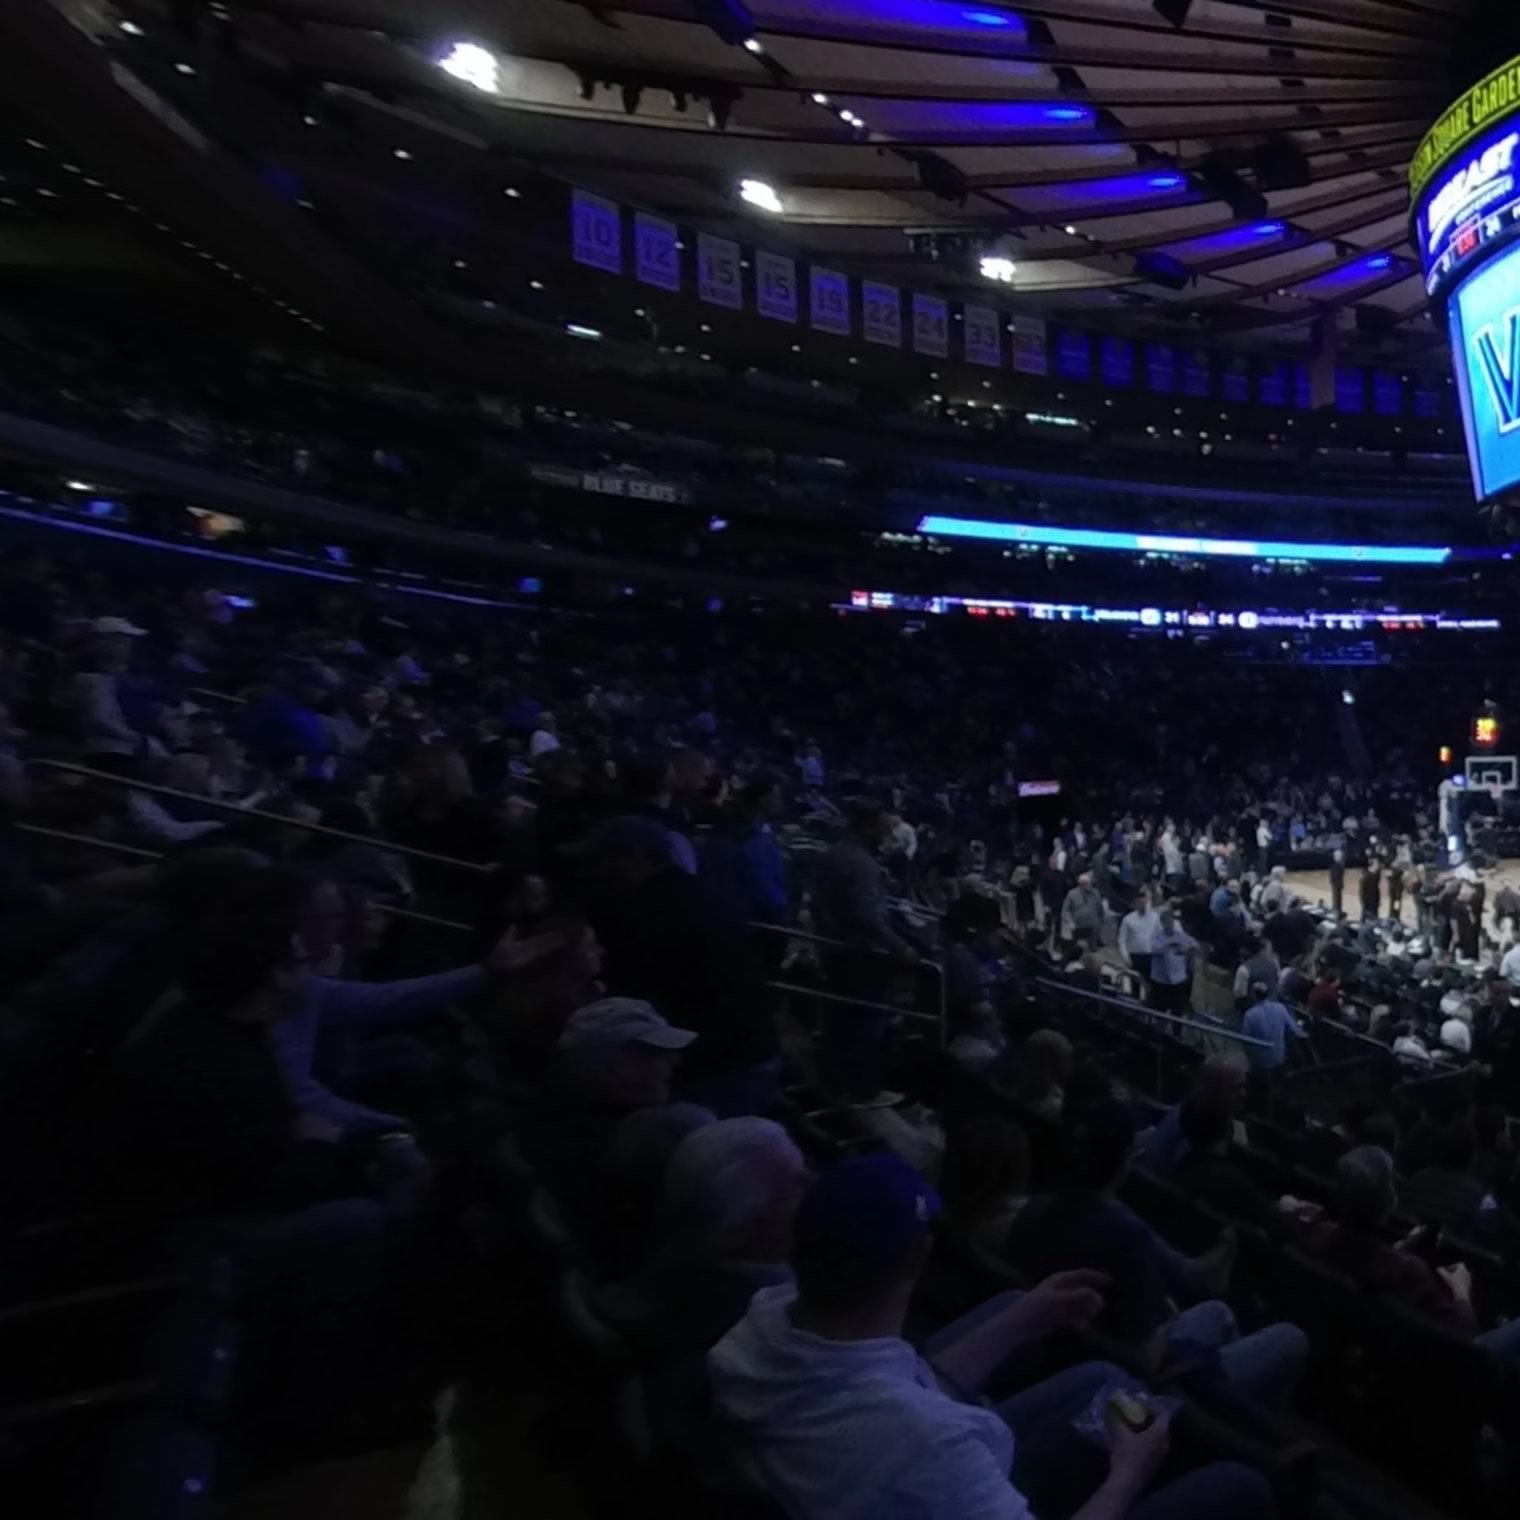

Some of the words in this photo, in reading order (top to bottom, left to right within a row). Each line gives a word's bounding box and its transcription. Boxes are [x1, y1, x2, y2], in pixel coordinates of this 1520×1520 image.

[641, 235, 671, 268] 12
[705, 254, 734, 286] 15
[762, 271, 791, 301] 15
[867, 299, 898, 327] 22
[967, 322, 997, 348] 33
[629, 479, 675, 502] SEATS
